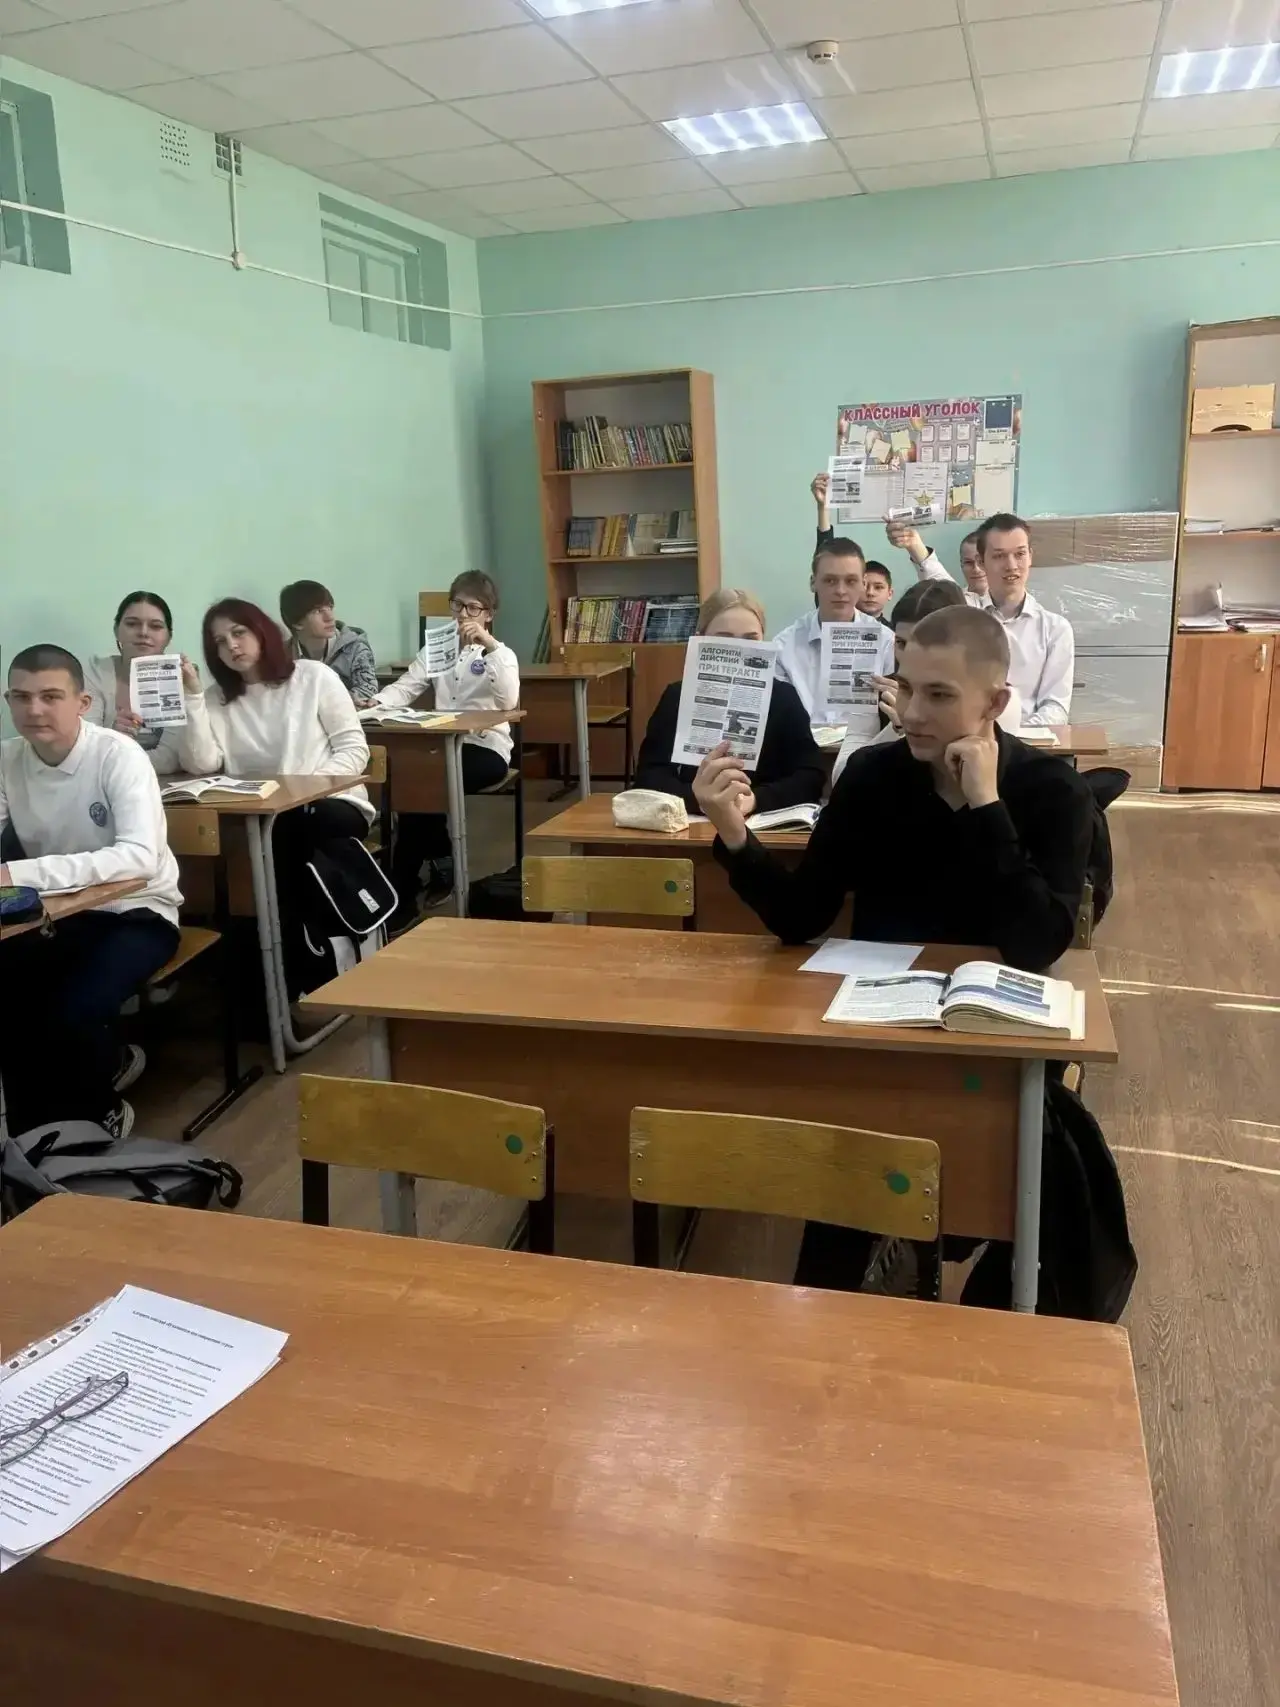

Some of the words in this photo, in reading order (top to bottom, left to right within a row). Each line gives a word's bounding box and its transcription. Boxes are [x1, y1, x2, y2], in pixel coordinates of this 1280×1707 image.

[844, 403, 920, 422] КЛАССНЫЙ
[925, 401, 981, 417] УГОЛОК
[701, 647, 742, 657] АЛГОРИТМ
[700, 654, 739, 664] ДЕЙСТВИЙ
[698, 663, 719, 673] ПРИ
[721, 665, 761, 678] ТЕРАКТЕ
